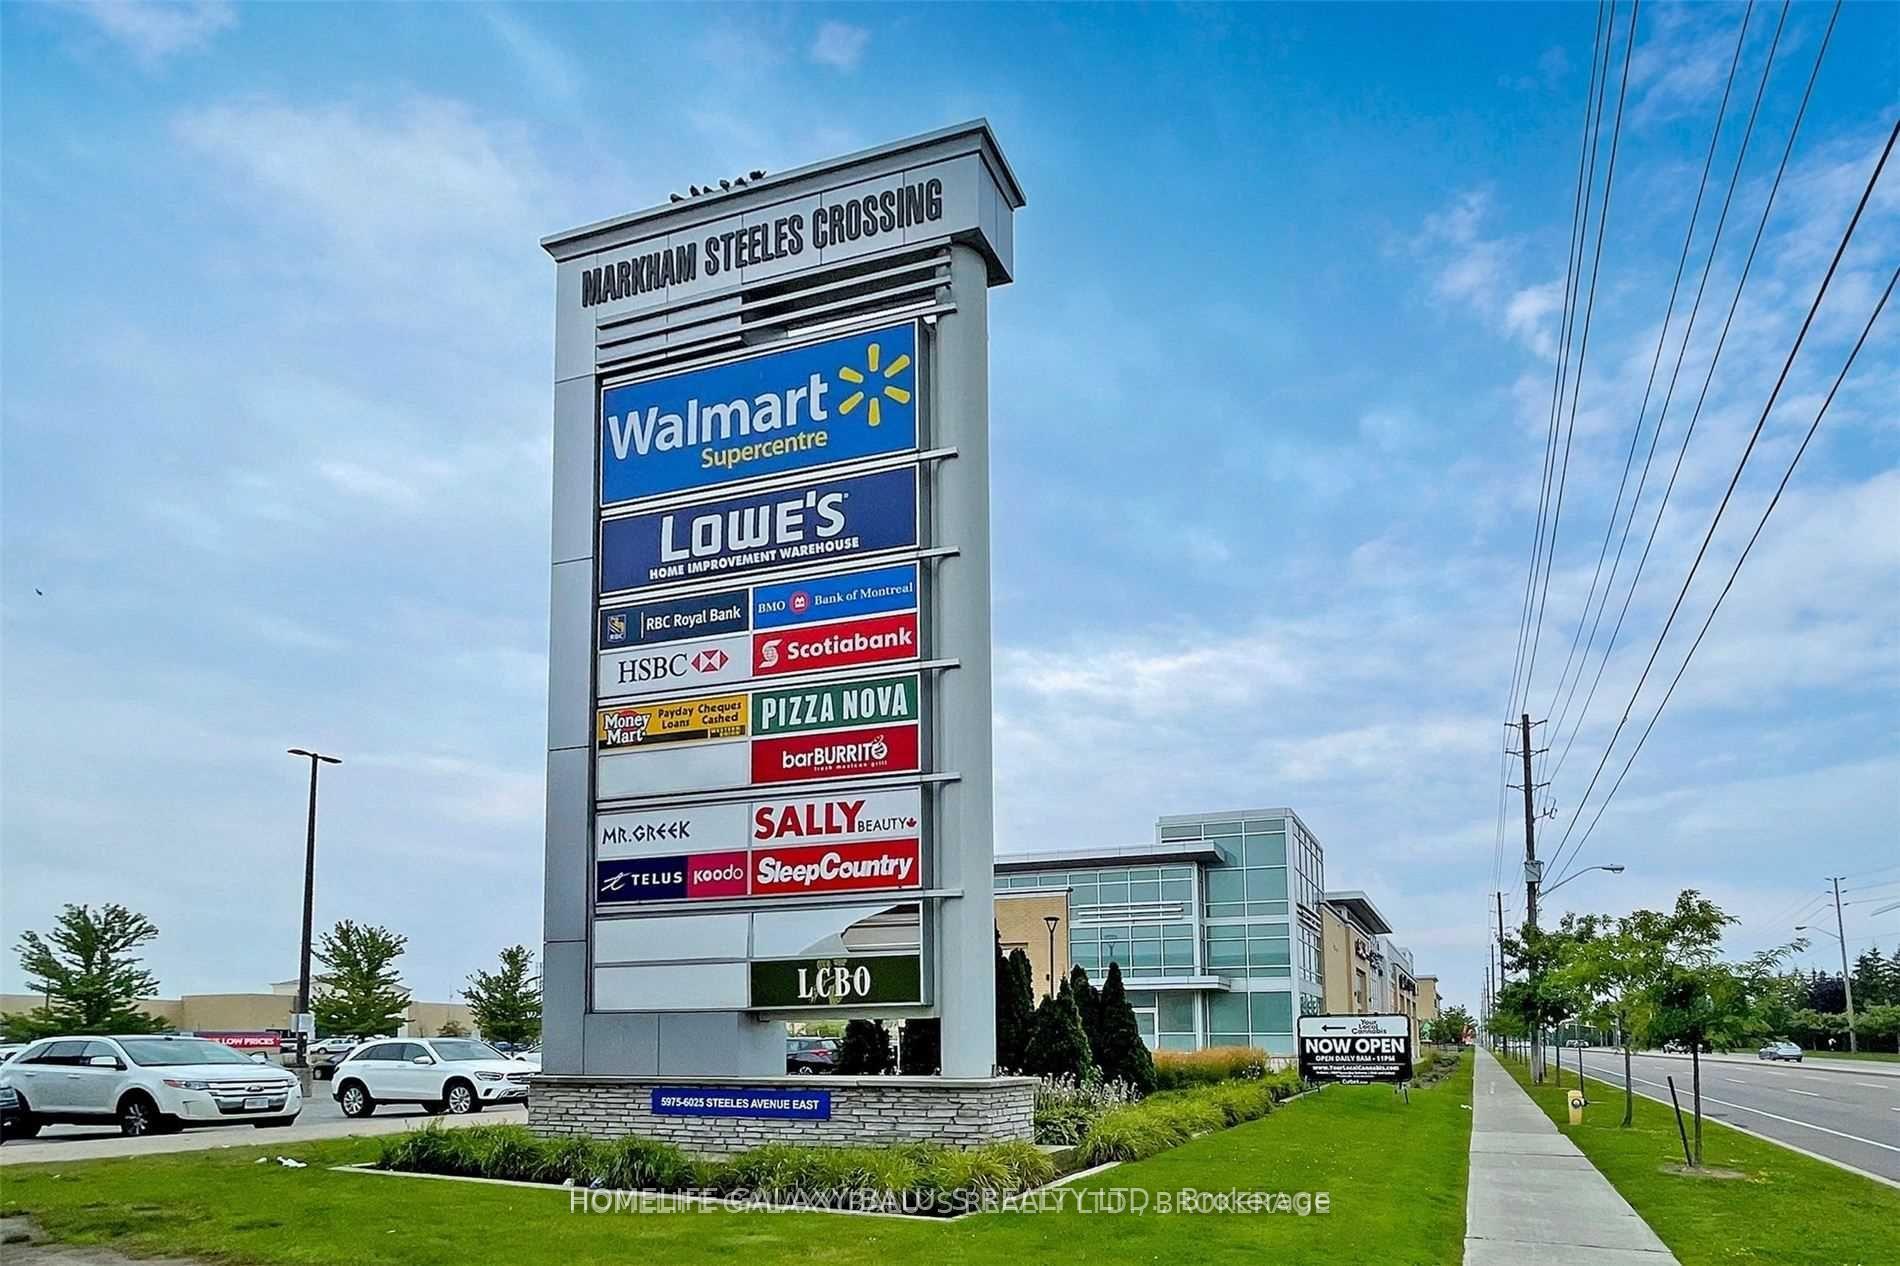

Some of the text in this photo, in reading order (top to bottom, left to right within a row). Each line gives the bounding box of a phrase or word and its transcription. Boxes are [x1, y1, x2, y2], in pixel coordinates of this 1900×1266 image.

[582, 179, 942, 307] MARKHAM STEELES CROSSING
[608, 373, 828, 460] Walmart
[701, 430, 828, 469] Supercentre
[661, 491, 845, 562] LOWE'S
[649, 537, 859, 580] HOME IMPROVEMENT WAREHOUSE
[758, 601, 786, 613] BMO
[815, 582, 913, 606] Bank of Montreal
[646, 605, 741, 631] RBC Royal Bank
[787, 627, 913, 660] Scotiabank
[618, 654, 688, 684] HSBC
[658, 702, 742, 719] Payday Cheques
[762, 683, 908, 730] PIZZA NOVA
[604, 713, 650, 730] Money
[662, 712, 739, 730] Loans Cashed
[606, 729, 643, 745] Mart
[782, 738, 888, 769] barBURRITO
[754, 800, 906, 840] SALLY BEAUTY
[632, 871, 683, 887] TELUS
[693, 863, 744, 885] koodo
[798, 965, 871, 999] LCBO
[244, 1037, 274, 1046] PRICES
[1305, 1038, 1405, 1054] NOW OPEN
[661, 1097, 819, 1110] 5975-6025 STEELES AVENUE EAST
